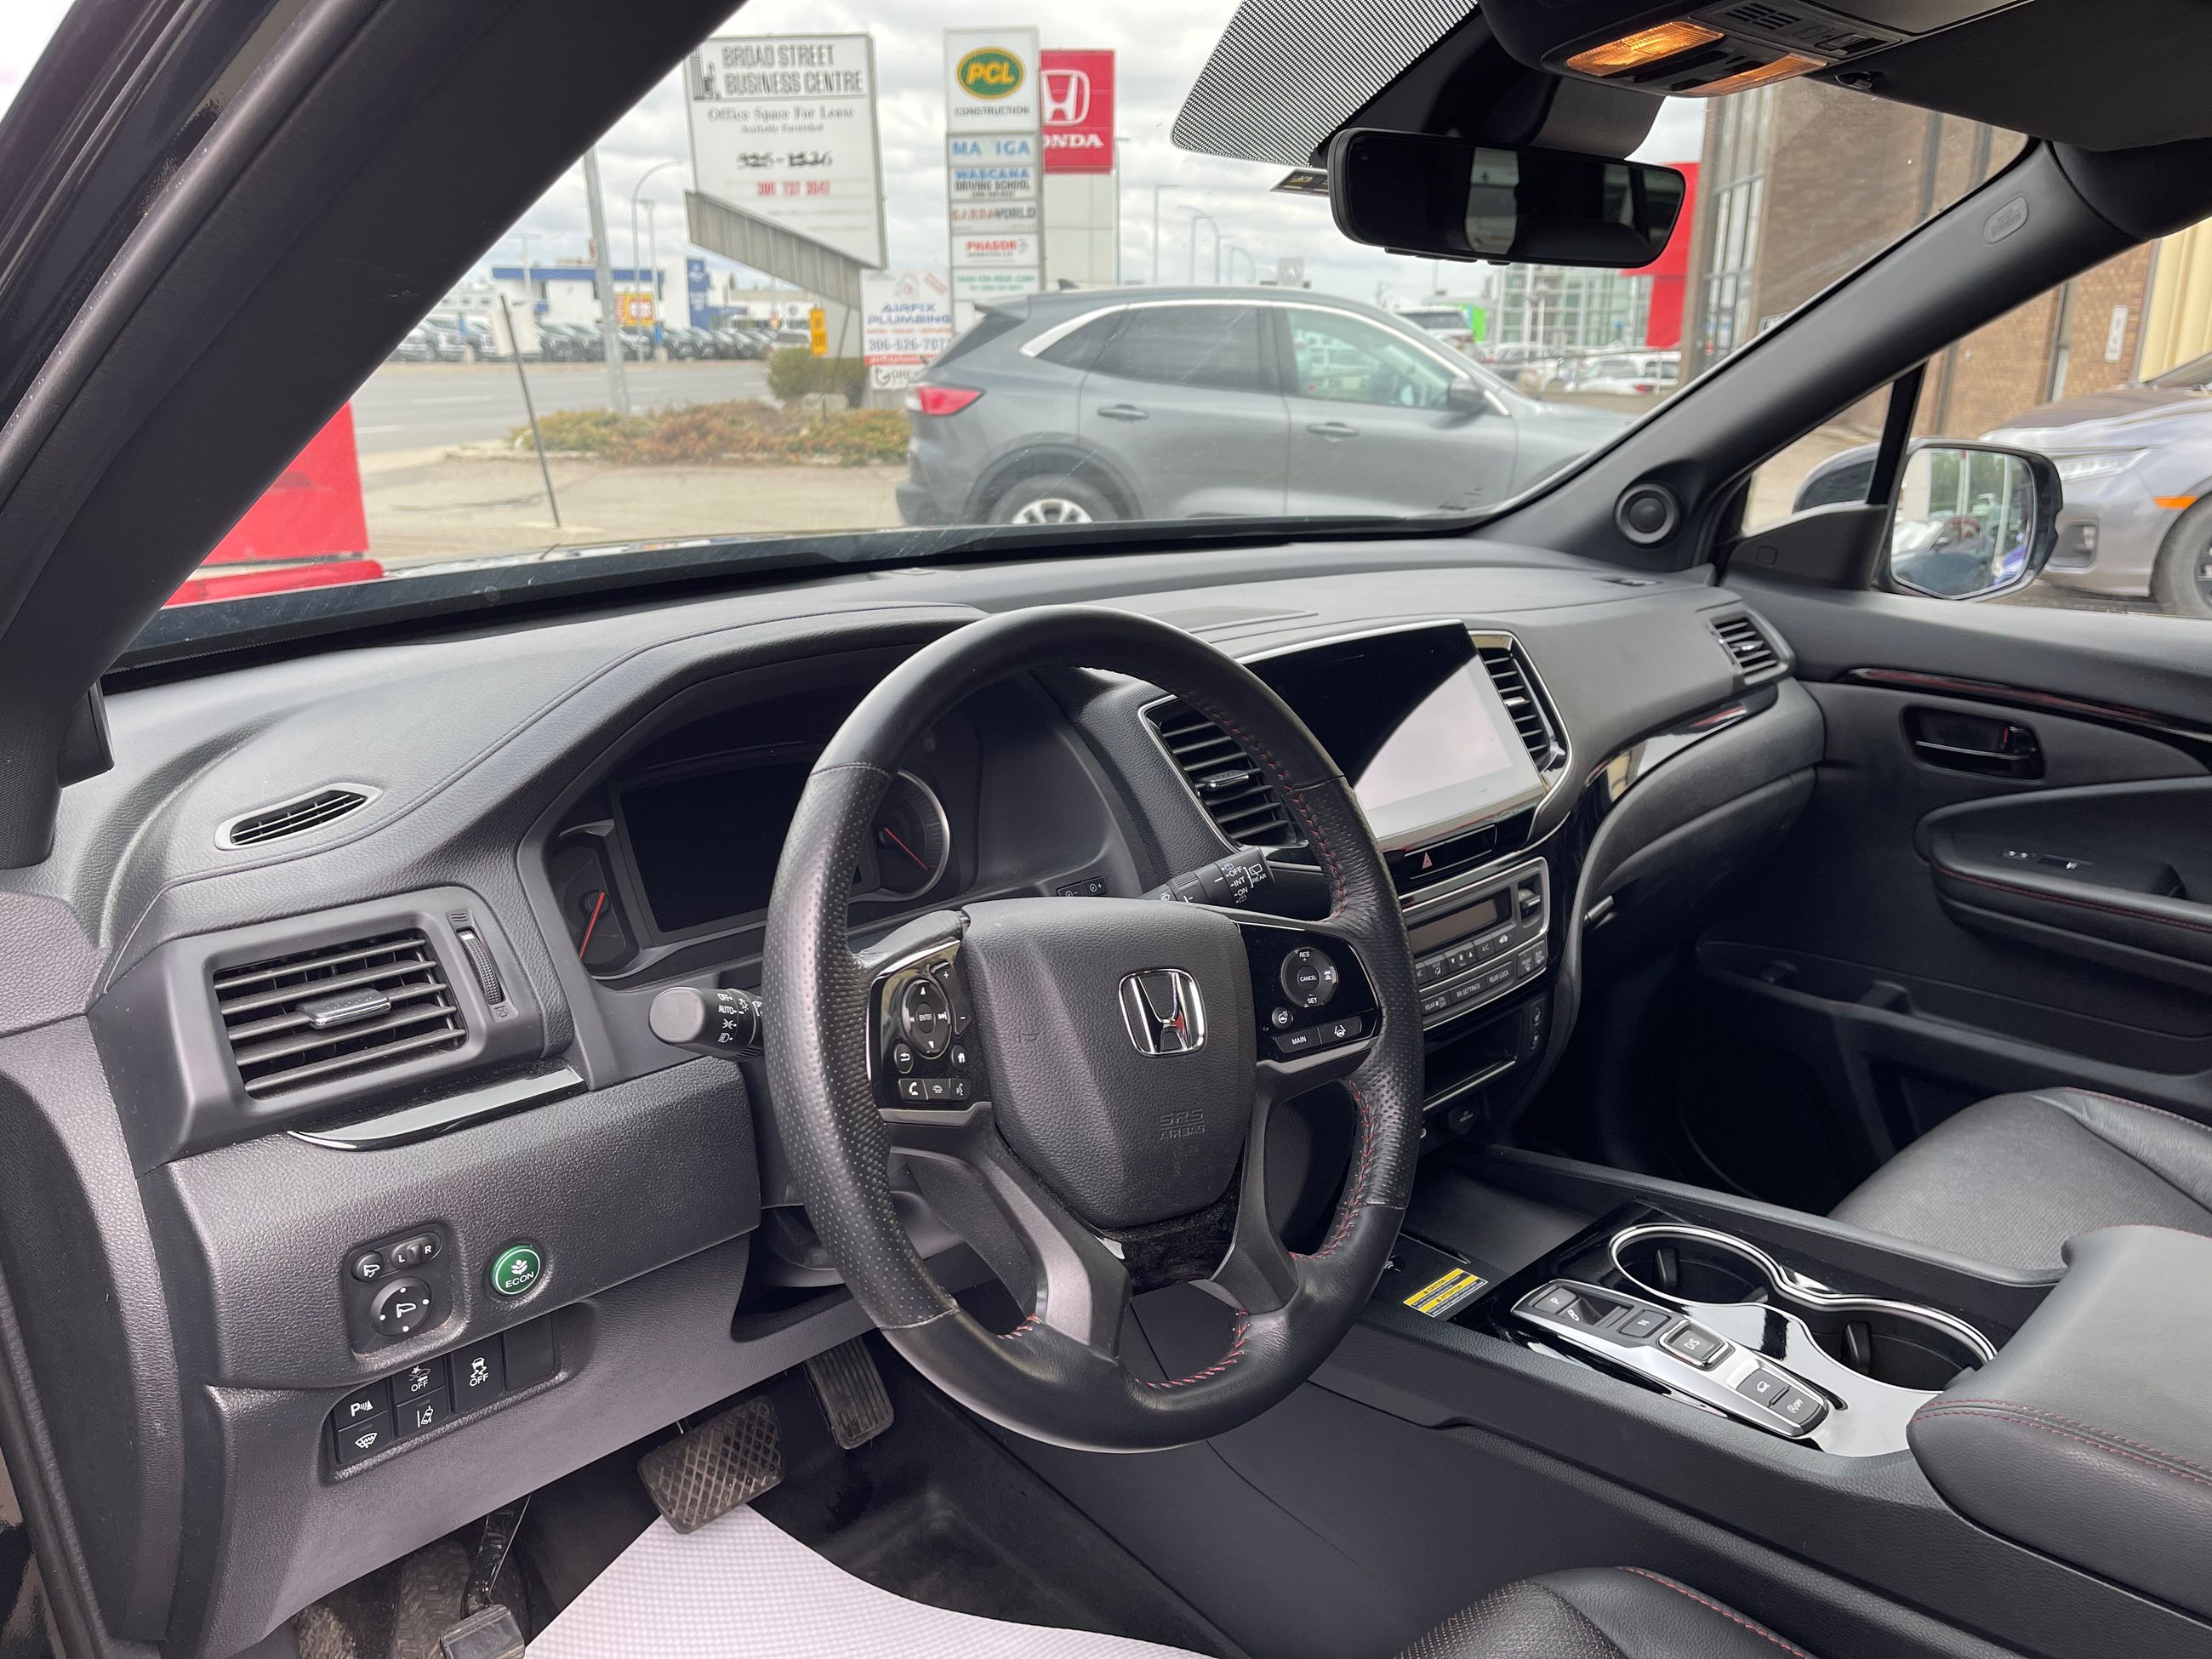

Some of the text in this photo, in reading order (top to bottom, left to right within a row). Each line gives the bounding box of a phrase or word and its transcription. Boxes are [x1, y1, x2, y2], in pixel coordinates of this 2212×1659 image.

[723, 44, 834, 67] BROAD STREET
[966, 62, 1016, 85] PCL
[724, 71, 864, 94] BUSINESS CENTRE
[708, 107, 750, 122] Office
[754, 106, 790, 123] Space
[820, 105, 855, 119] Lease
[954, 105, 1030, 117] CONSTRUCTION
[1042, 134, 1103, 148] ONDA
[955, 180, 1030, 191] DRIVING SCHOOL
[868, 314, 952, 324] PLUMBING
[1229, 866, 1242, 877] OFF
[1234, 876, 1246, 887] INT
[1252, 874, 1267, 884] REAR
[1237, 887, 1248, 896] ON
[718, 1005, 734, 1015] AUTO
[1291, 1036, 1307, 1045] MAIN
[398, 1245, 432, 1263] L R
[505, 1270, 534, 1289] ECON
[411, 1379, 429, 1393] OFF
[469, 1372, 489, 1387] OFF
